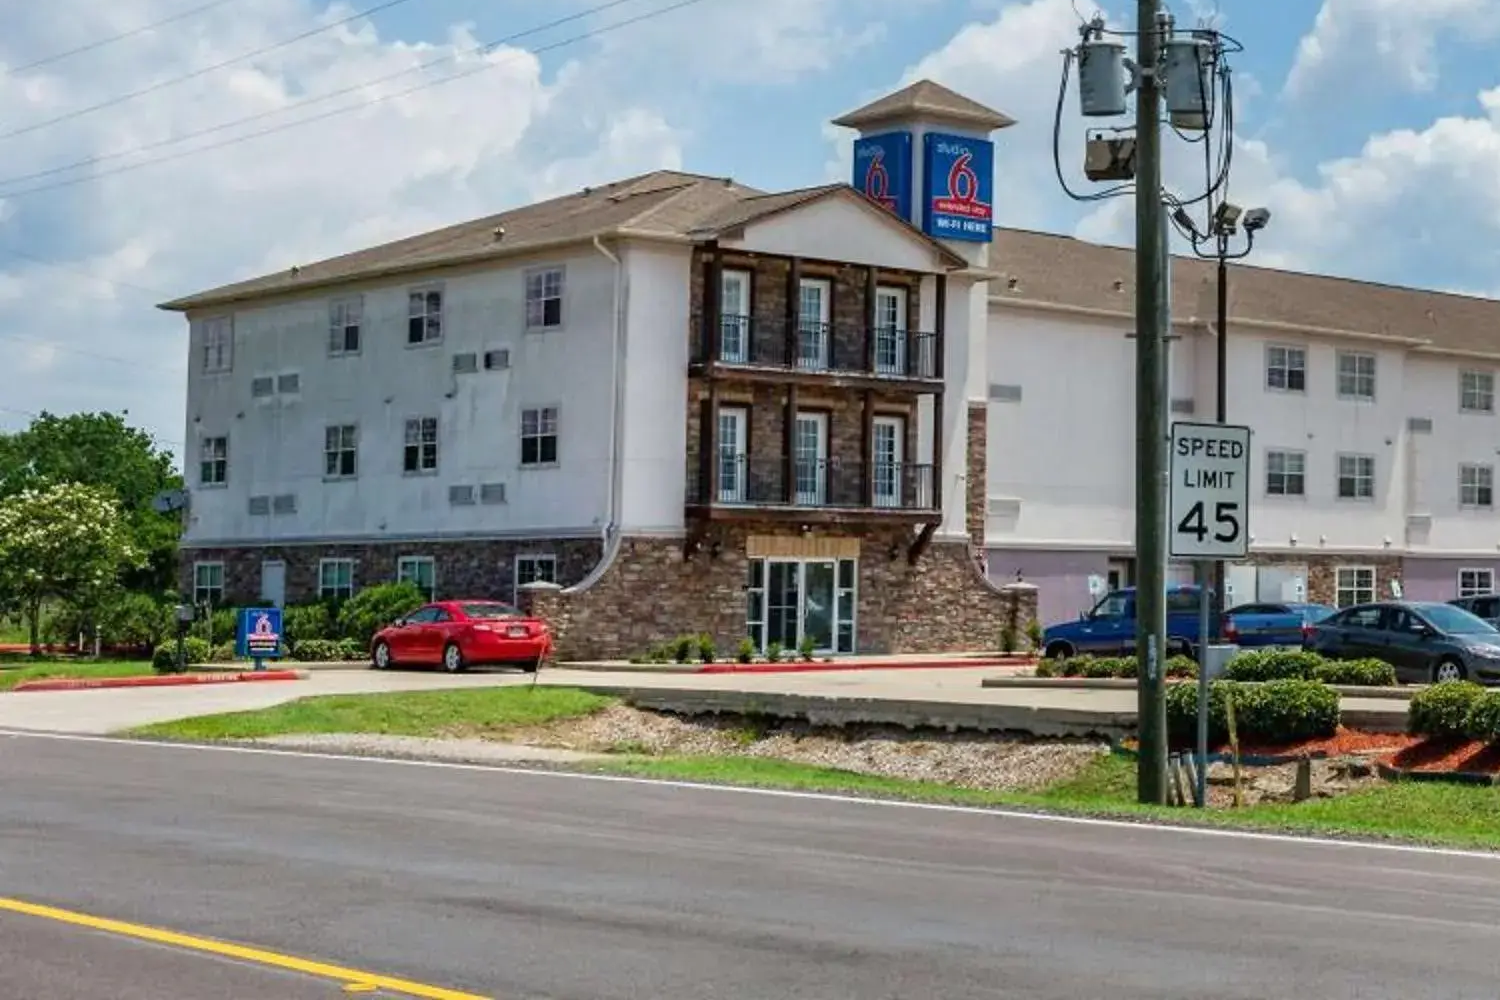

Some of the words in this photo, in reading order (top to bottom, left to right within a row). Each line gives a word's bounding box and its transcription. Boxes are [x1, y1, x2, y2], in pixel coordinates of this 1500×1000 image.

[948, 152, 978, 201] 6
[963, 221, 987, 233] HERE
[1177, 437, 1243, 459] SPEED
[1184, 469, 1235, 489] LIMIT
[1177, 500, 1239, 542] 45
